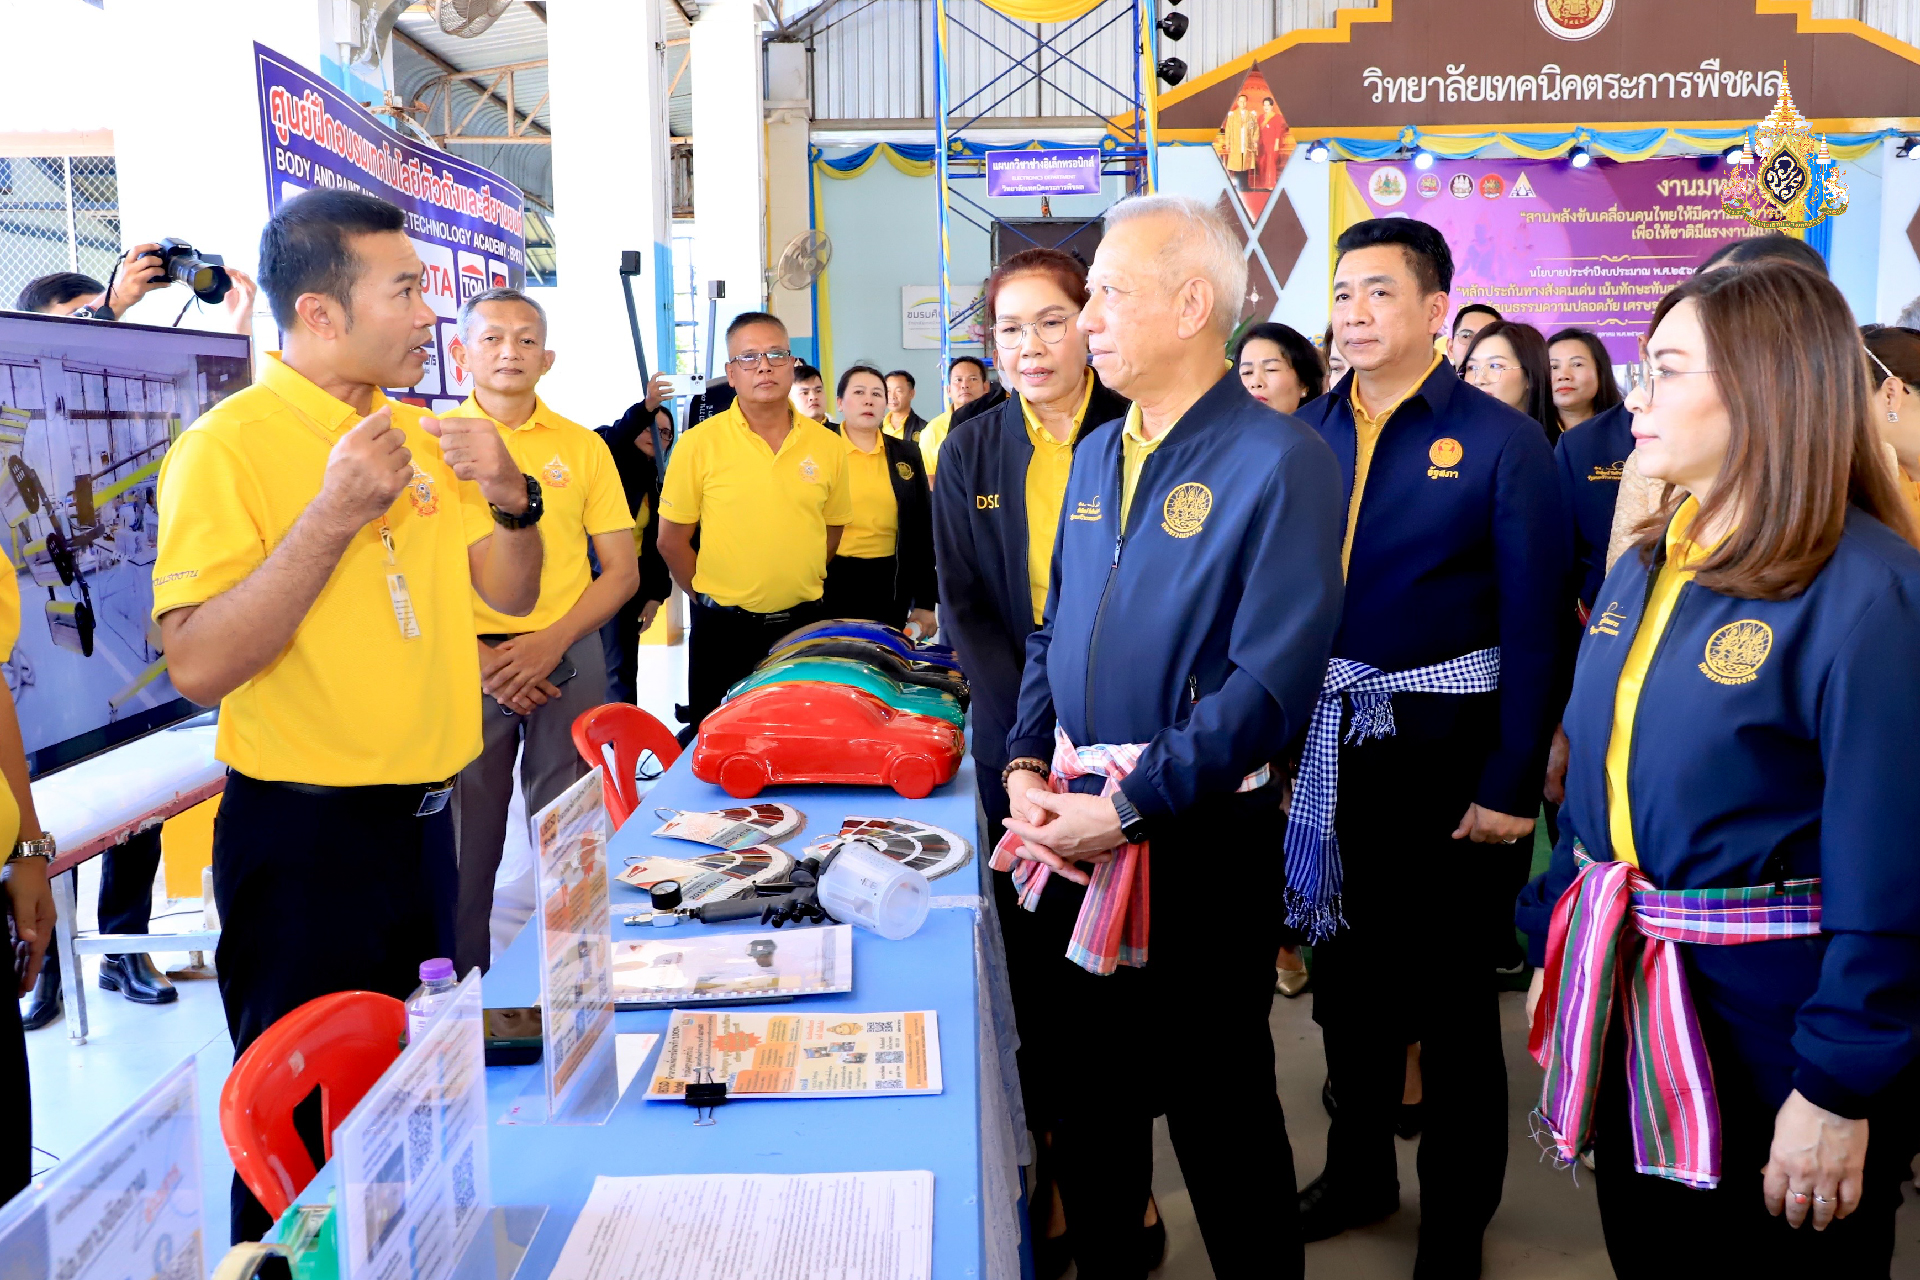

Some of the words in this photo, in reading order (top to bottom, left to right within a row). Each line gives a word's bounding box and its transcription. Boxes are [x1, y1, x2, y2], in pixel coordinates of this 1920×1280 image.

[1362, 58, 1783, 103] วิทยาลัยเทคนิคตระการพืชผล
[275, 147, 311, 178] BODY
[314, 165, 336, 190] AND
[410, 213, 472, 246] TECHNOLOGY
[473, 232, 507, 258] ACADEMY
[421, 261, 453, 298] OTA
